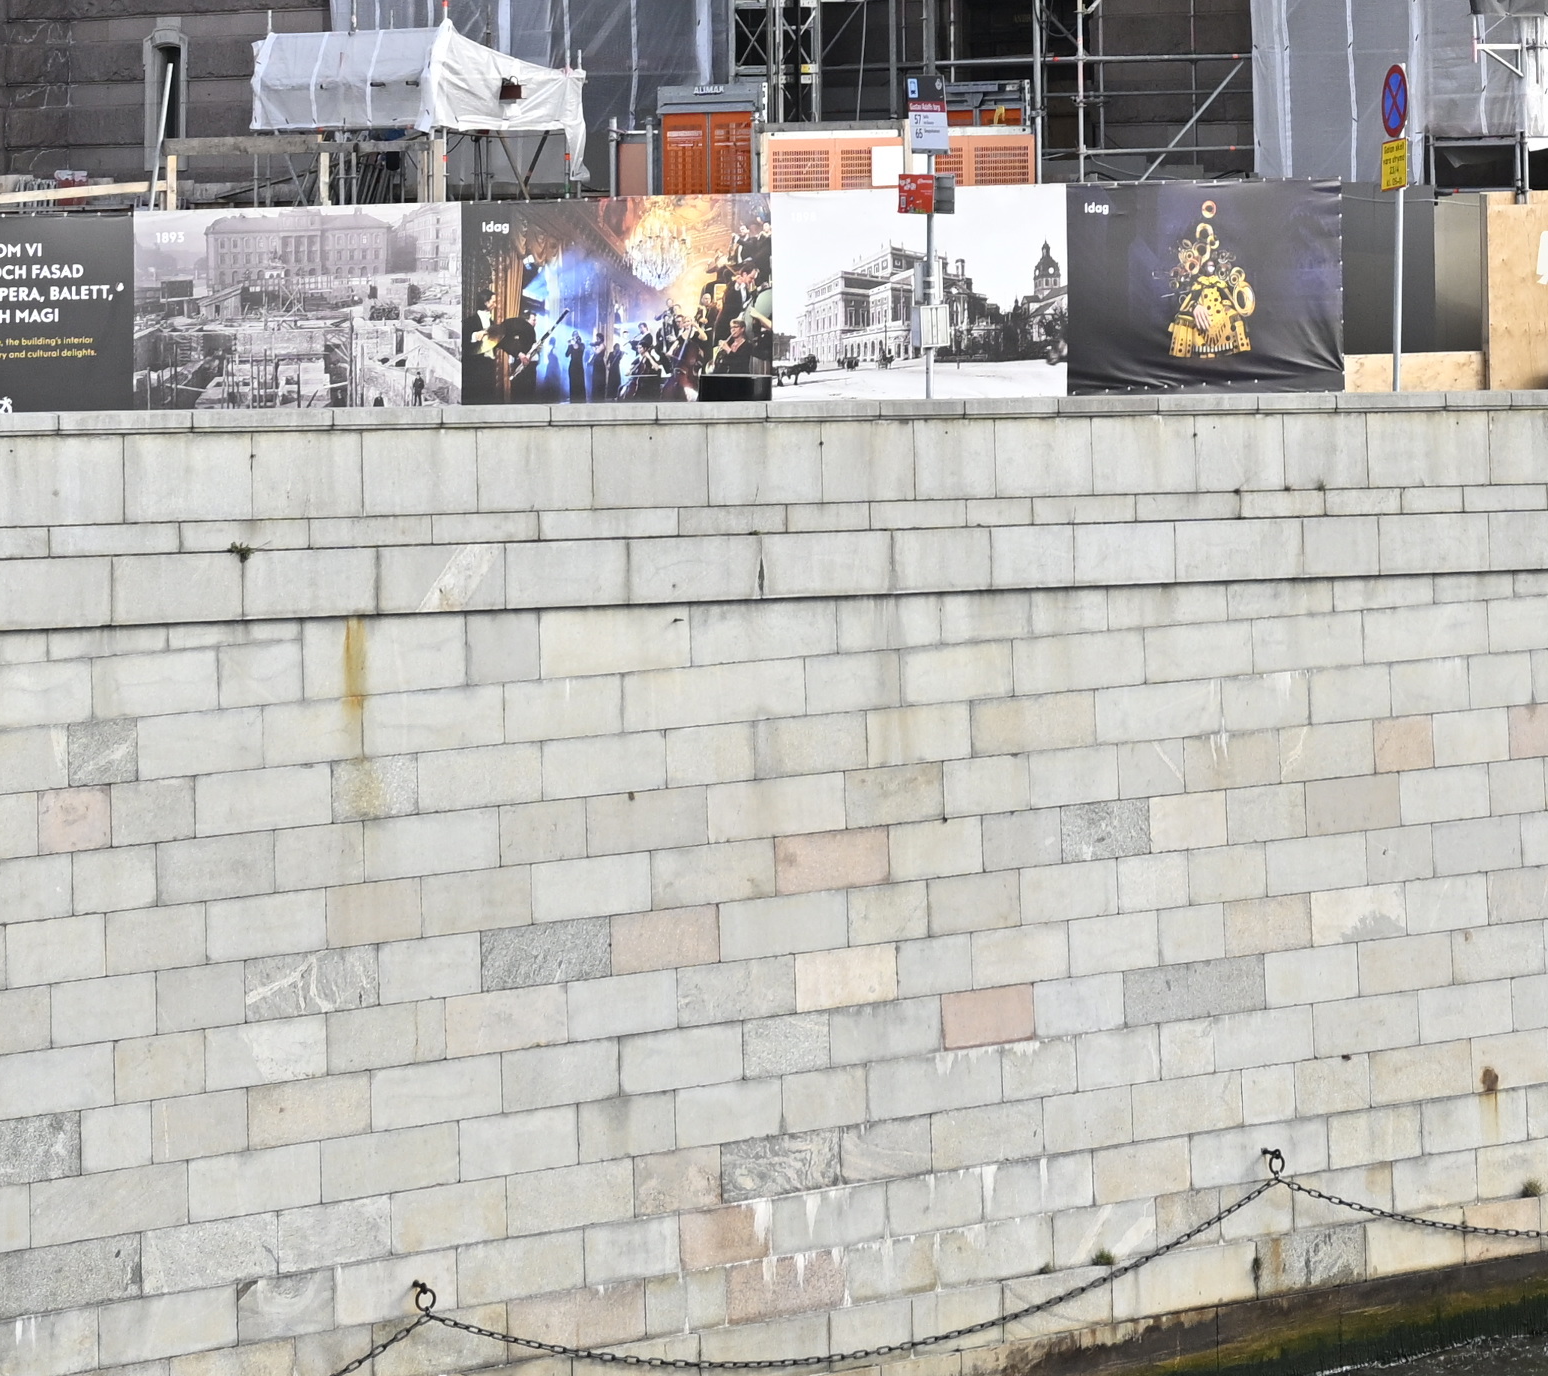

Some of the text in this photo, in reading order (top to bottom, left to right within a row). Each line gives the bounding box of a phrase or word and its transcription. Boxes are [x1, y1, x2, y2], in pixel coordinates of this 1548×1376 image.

[693, 85, 725, 95] ALIMAK
[914, 114, 921, 125] 57
[915, 128, 923, 139] 65
[1084, 201, 1109, 215] Idag
[482, 221, 510, 234] Idag
[25, 243, 43, 257] VI
[32, 264, 84, 279] FASAD
[50, 284, 114, 301] BALETT,
[16, 308, 59, 323] MAGI
[6, 338, 19, 346] the
[21, 337, 61, 347] building's
[63, 336, 93, 345] interior
[8, 350, 26, 358] and
[28, 349, 60, 358] cultural
[62, 347, 97, 358] delights.
